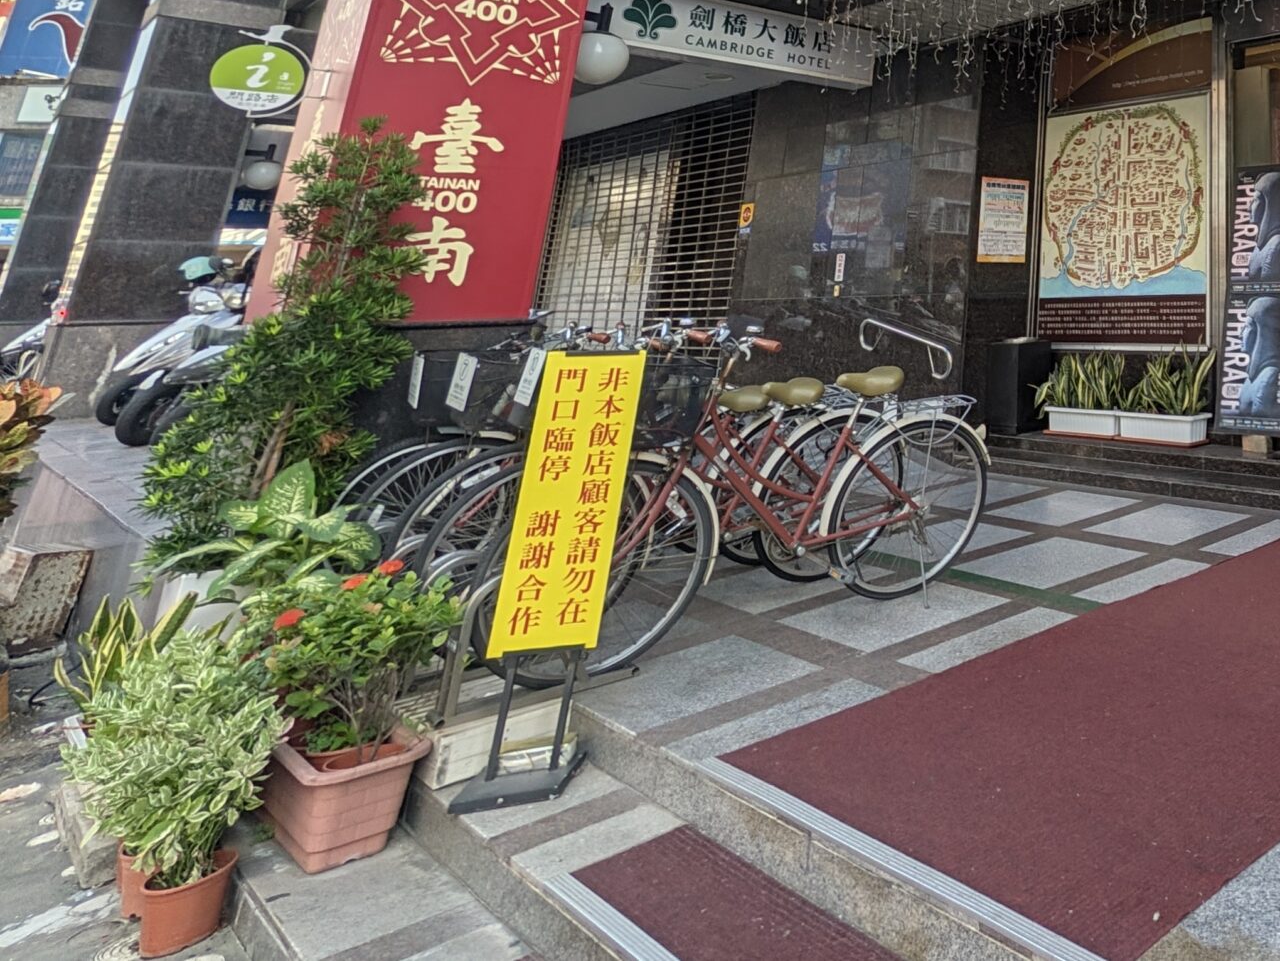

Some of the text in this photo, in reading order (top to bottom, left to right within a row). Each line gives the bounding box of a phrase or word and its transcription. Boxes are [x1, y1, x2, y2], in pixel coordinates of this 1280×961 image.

[685, 34, 831, 70] CAMBRIDGE HOTEL
[688, 4, 835, 54] 劍橋大飯店
[408, 97, 504, 174] 臺
[411, 190, 478, 213] 400
[418, 175, 480, 191] TAINAN
[405, 216, 475, 287] 南
[1230, 184, 1259, 281] PHARAOH
[1220, 308, 1250, 415] PHARAOH
[508, 368, 589, 637] 門口臨停 謝謝合作
[556, 367, 630, 626] 非本飯店顧客請勿在
